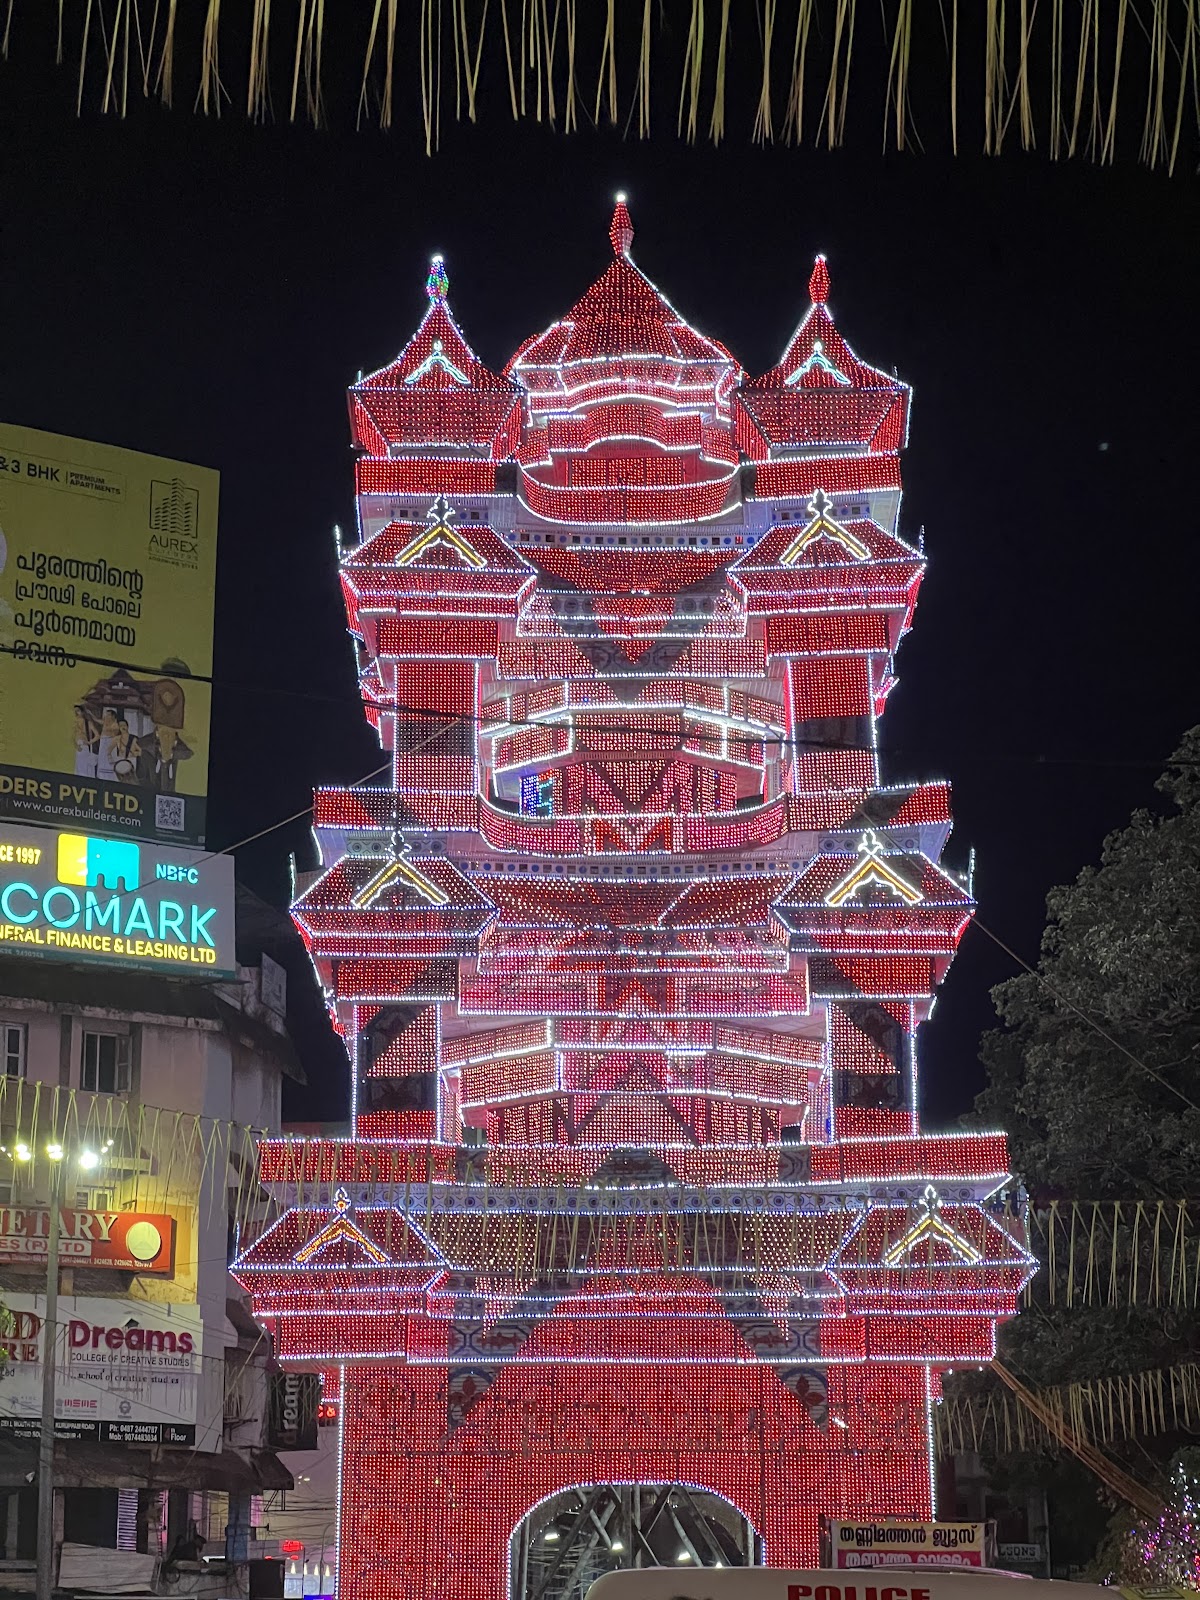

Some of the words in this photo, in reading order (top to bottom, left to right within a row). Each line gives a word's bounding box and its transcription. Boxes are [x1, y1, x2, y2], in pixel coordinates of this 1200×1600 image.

[27, 463, 61, 483] BHK
[70, 472, 105, 484] PREMIUM
[70, 479, 121, 495] APARTMENTS
[149, 534, 199, 556] AUREX
[81, 592, 142, 619] പോലെ
[0, 775, 52, 800] DERS
[59, 783, 98, 807] PVT
[104, 791, 144, 815] LTD.
[13, 799, 142, 828] www.aurexbuilders.com
[15, 846, 41, 866] 1997
[156, 863, 199, 885] NBFC
[1, 882, 217, 947] COMARK
[46, 929, 111, 952] FINANCE
[113, 938, 124, 951] &
[126, 939, 188, 961] LEASING
[190, 946, 216, 964] LTD
[68, 1319, 193, 1354] Dreams
[71, 1352, 107, 1363] COLLEGE
[108, 1354, 118, 1363] OF
[120, 1354, 156, 1366] CREATIVE
[158, 1357, 190, 1368] STUDIES
[64, 1399, 98, 1408] MSME
[109, 1424, 119, 1432] Ph:
[120, 1425, 134, 1433] 0487
[109, 1433, 123, 1441] Mob:
[840, 1525, 927, 1547] തണ്ണിമത്തൻ
[787, 1584, 931, 1600] POLICE
